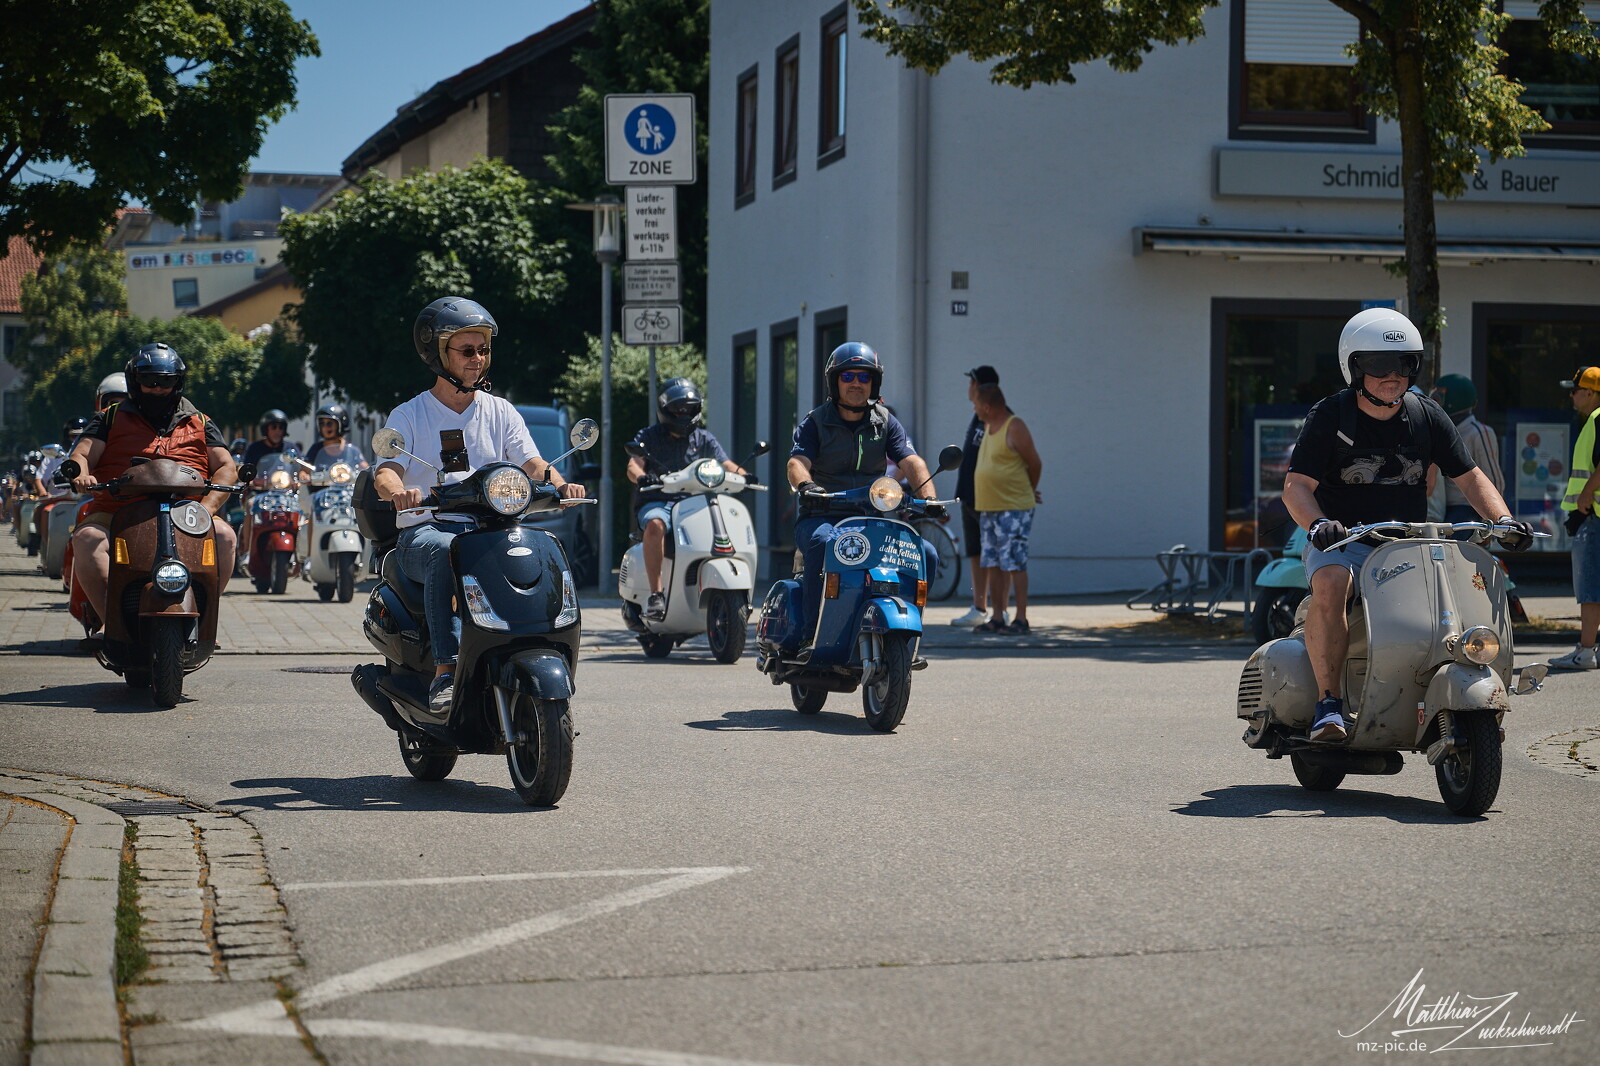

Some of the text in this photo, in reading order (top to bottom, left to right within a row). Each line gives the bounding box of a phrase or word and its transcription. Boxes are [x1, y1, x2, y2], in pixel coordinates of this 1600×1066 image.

[629, 160, 672, 175] ZONE
[1322, 163, 1560, 192] Schmid & Bauer
[636, 193, 665, 203] Liefer-
[635, 206, 666, 216] verkehr
[644, 218, 658, 228] frei
[633, 231, 670, 243] werktags
[954, 303, 966, 313] 19
[643, 332, 662, 341] frei
[1385, 331, 1405, 341] NOLAN
[185, 505, 197, 527] 6
[891, 537, 917, 550] segreto
[879, 544, 898, 554] della
[1371, 560, 1416, 587] Vespa
